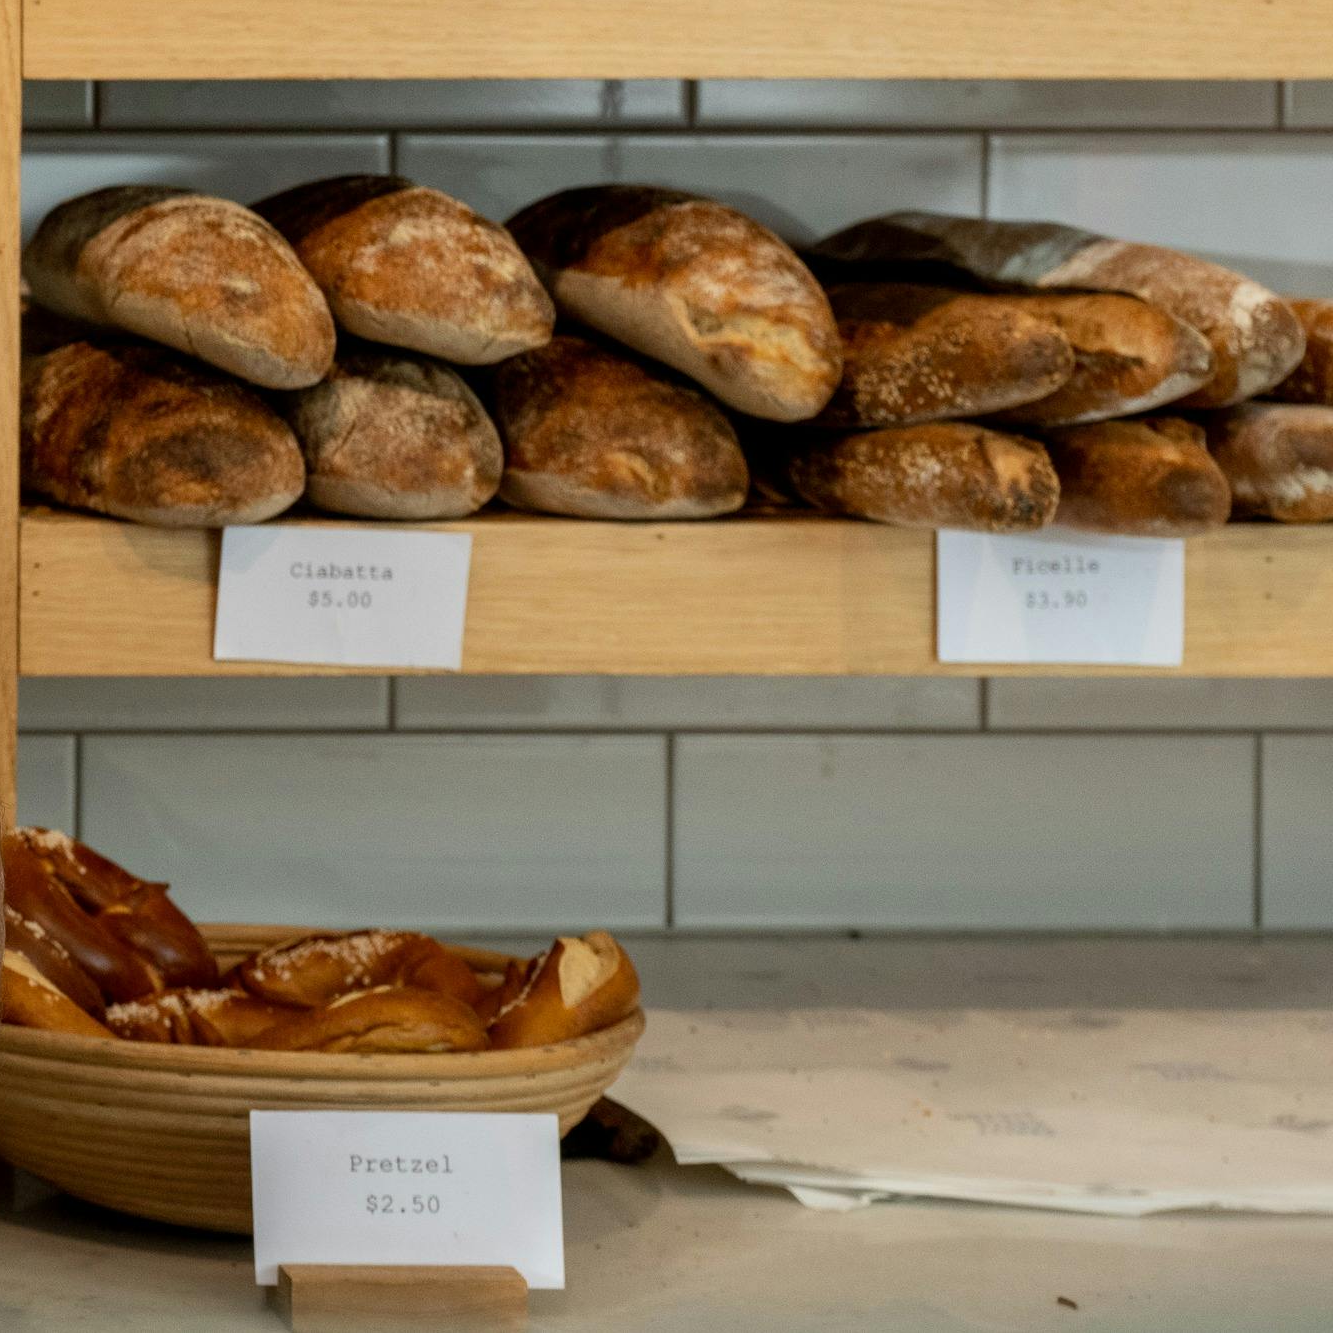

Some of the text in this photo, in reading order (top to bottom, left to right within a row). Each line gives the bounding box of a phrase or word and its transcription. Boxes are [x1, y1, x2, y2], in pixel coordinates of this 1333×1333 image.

[289, 562, 394, 581] Ciabatta
[307, 590, 373, 609] $5.00
[349, 1153, 454, 1174] Pretzel
[366, 1194, 441, 1215] $2.50
